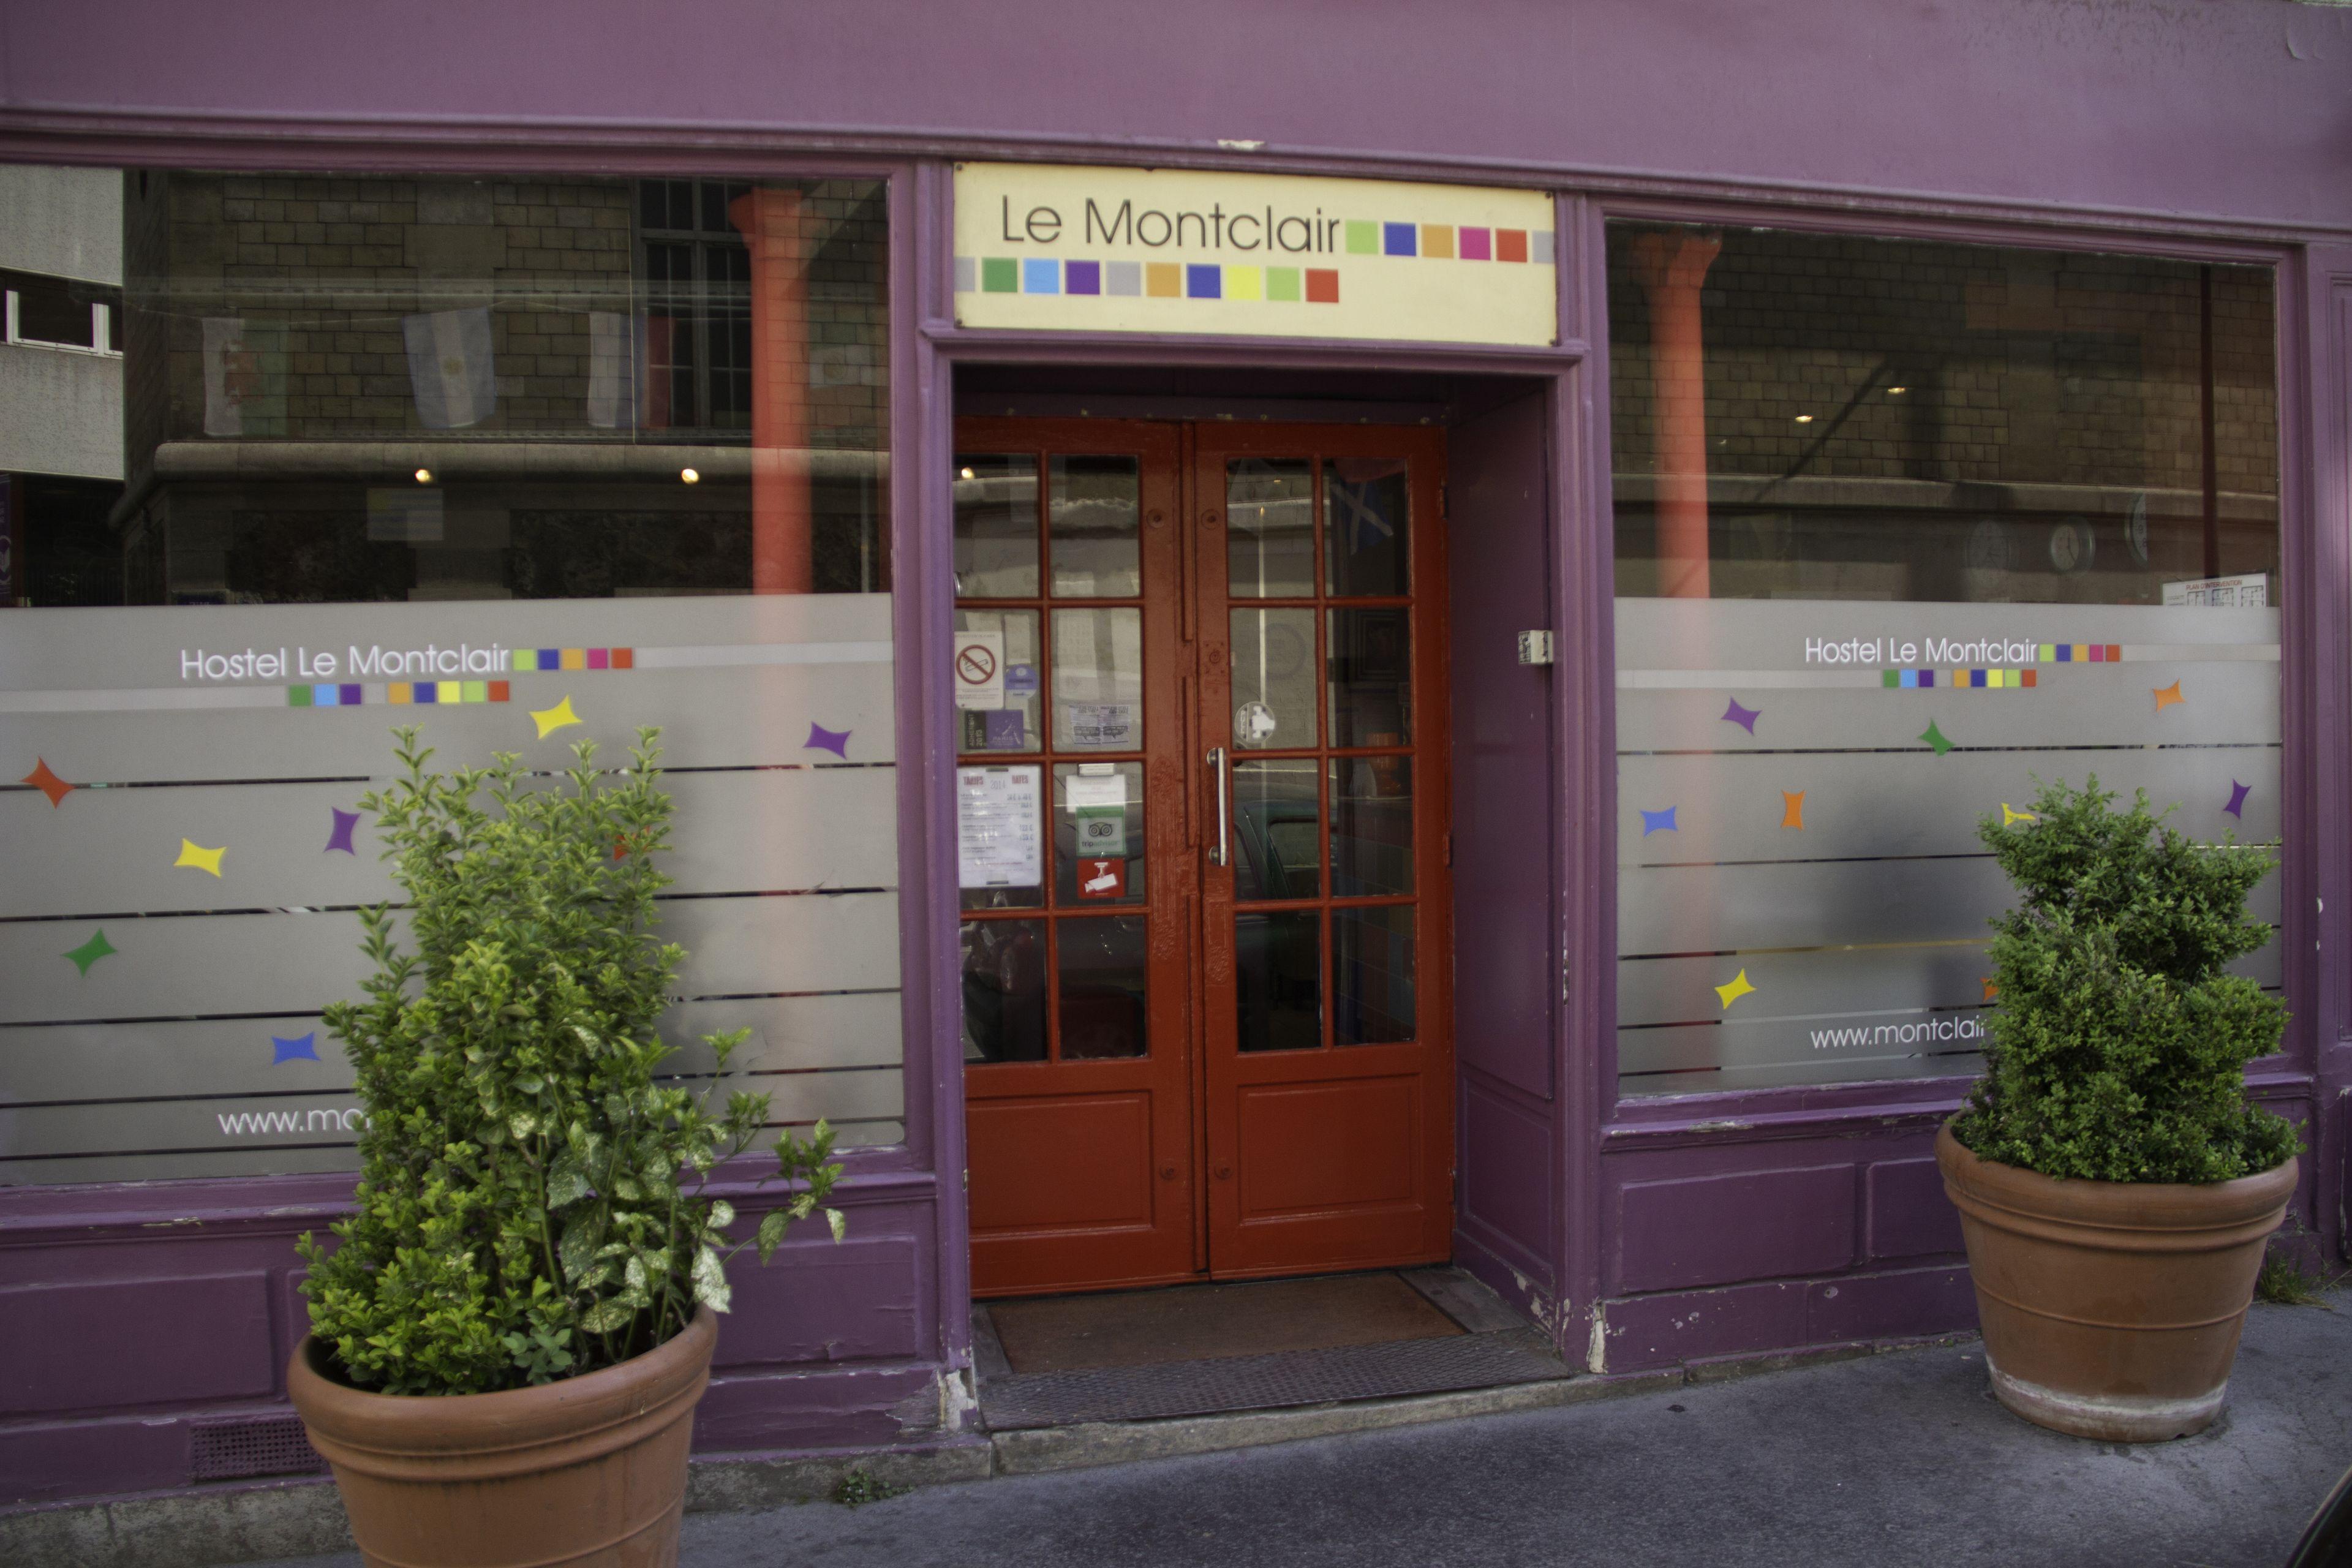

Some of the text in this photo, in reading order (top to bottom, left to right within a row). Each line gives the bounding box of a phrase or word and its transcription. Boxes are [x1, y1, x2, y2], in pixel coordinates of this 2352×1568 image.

[1001, 194, 1340, 253] Le Montclair
[2200, 579, 2243, 589] D'INTERVENTION
[181, 643, 509, 679] Hostel Le Montclair
[1805, 637, 2037, 663] Hostel Le Montclair
[963, 776, 983, 785] TARIFS
[1011, 775, 1029, 784] RATES
[217, 1107, 371, 1134] www.mo
